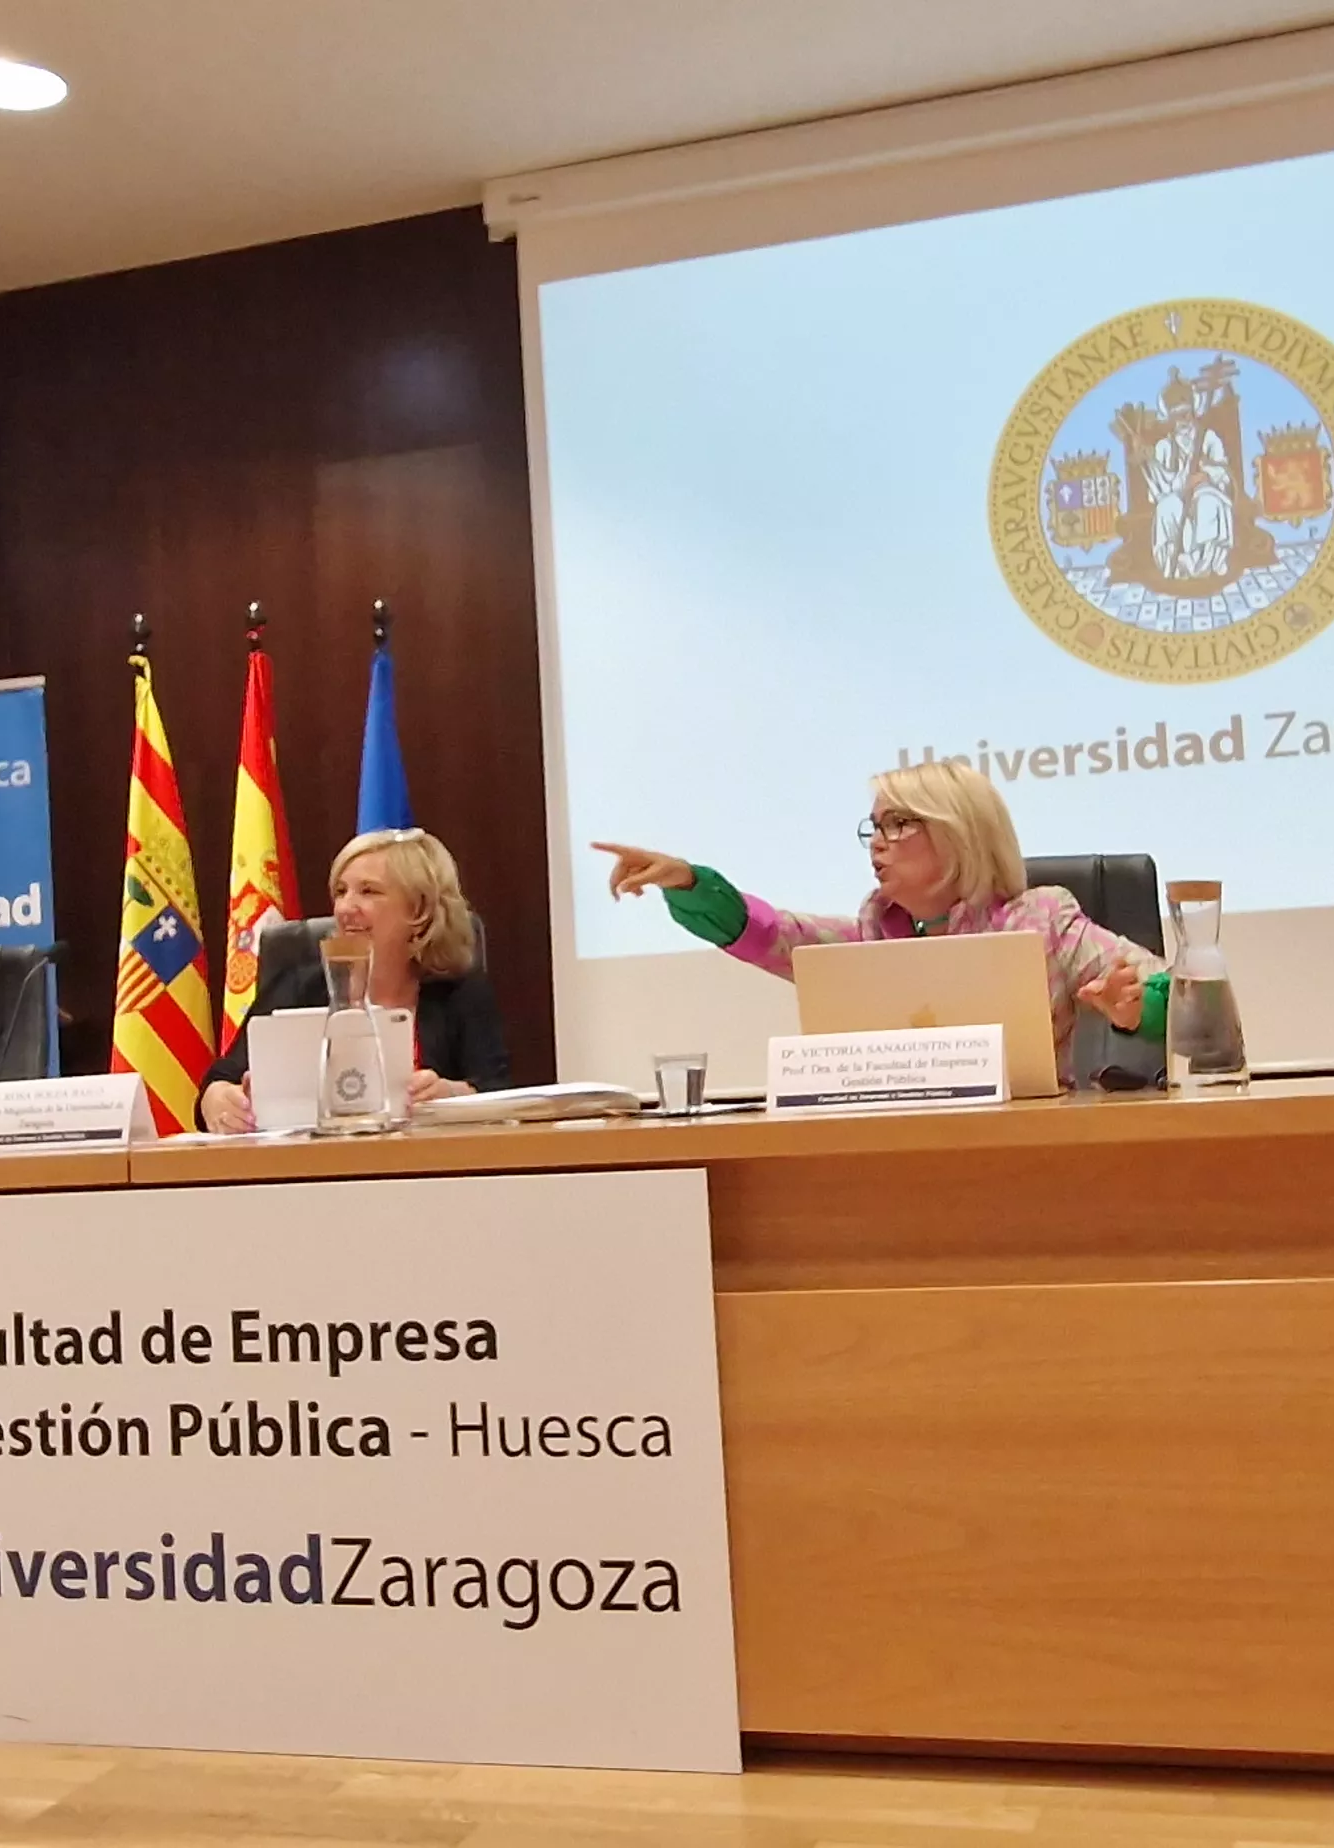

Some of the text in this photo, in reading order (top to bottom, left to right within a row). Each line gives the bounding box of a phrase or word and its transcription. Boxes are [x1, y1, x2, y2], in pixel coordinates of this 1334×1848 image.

[140, 1308, 213, 1366] de
[231, 1309, 498, 1378] Empresa
[169, 1399, 392, 1458] Pública
[449, 1401, 672, 1458] Huesca
